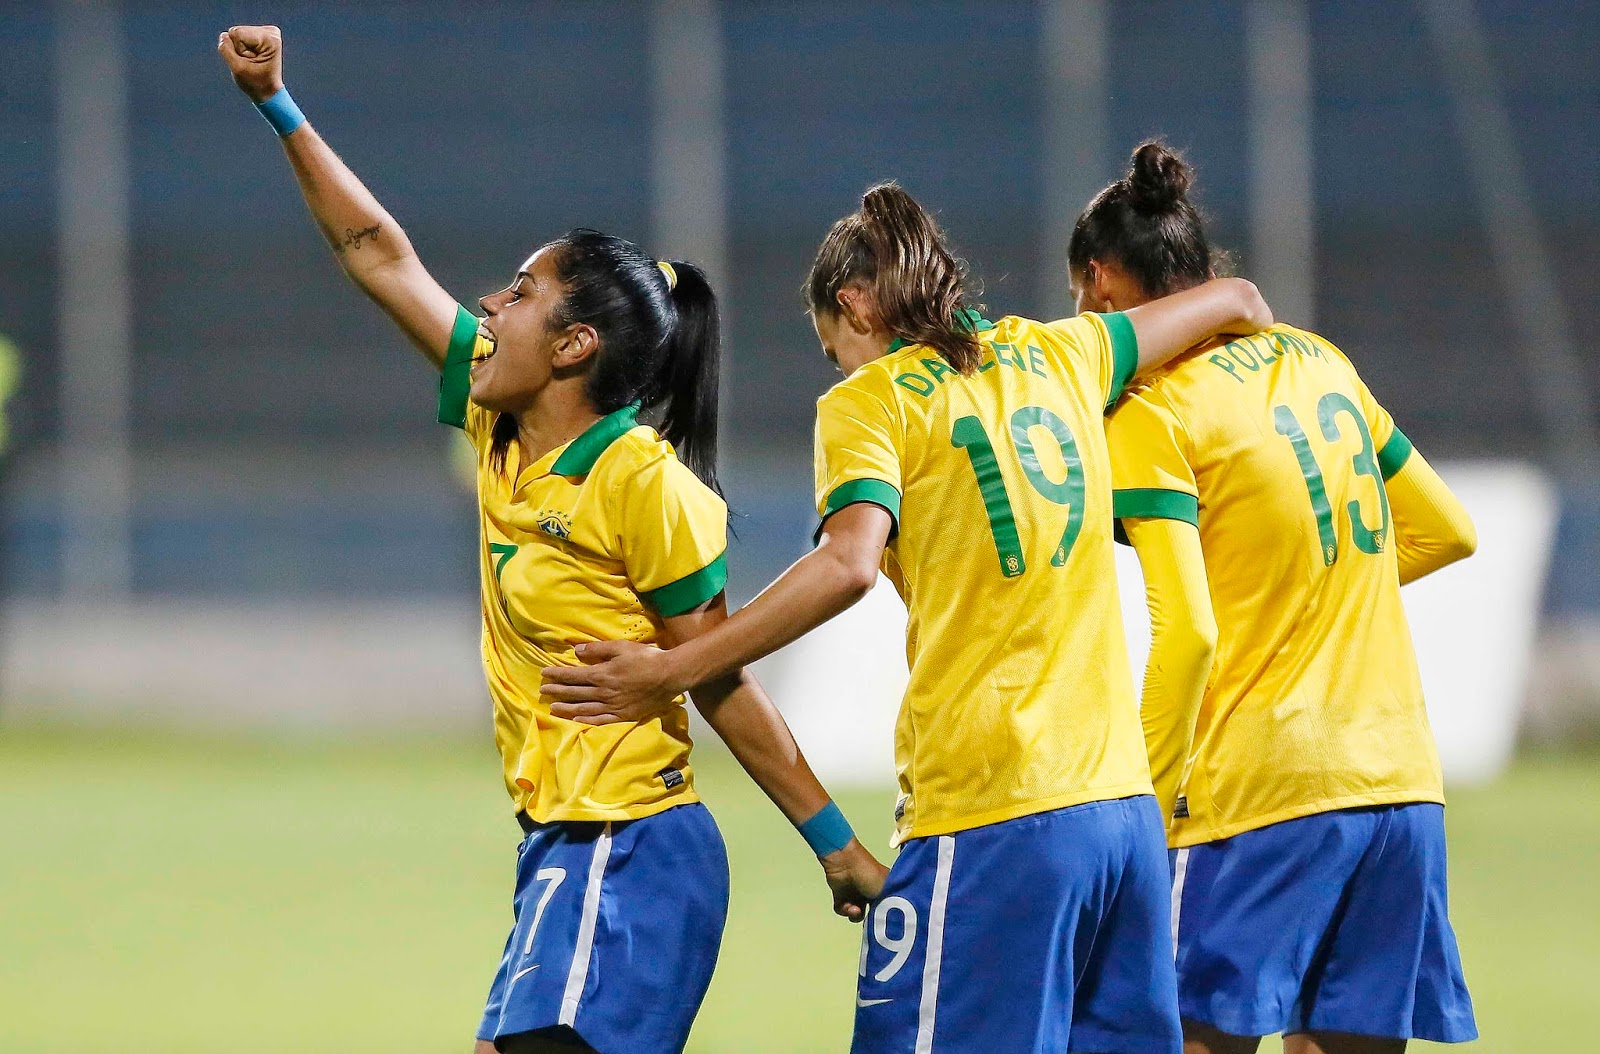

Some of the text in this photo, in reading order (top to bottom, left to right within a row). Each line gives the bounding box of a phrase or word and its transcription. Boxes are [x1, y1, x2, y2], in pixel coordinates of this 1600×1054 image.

[894, 341, 1047, 397] DAENE
[951, 406, 1086, 577] 19
[1274, 393, 1388, 567] 13
[524, 867, 566, 955] 7
